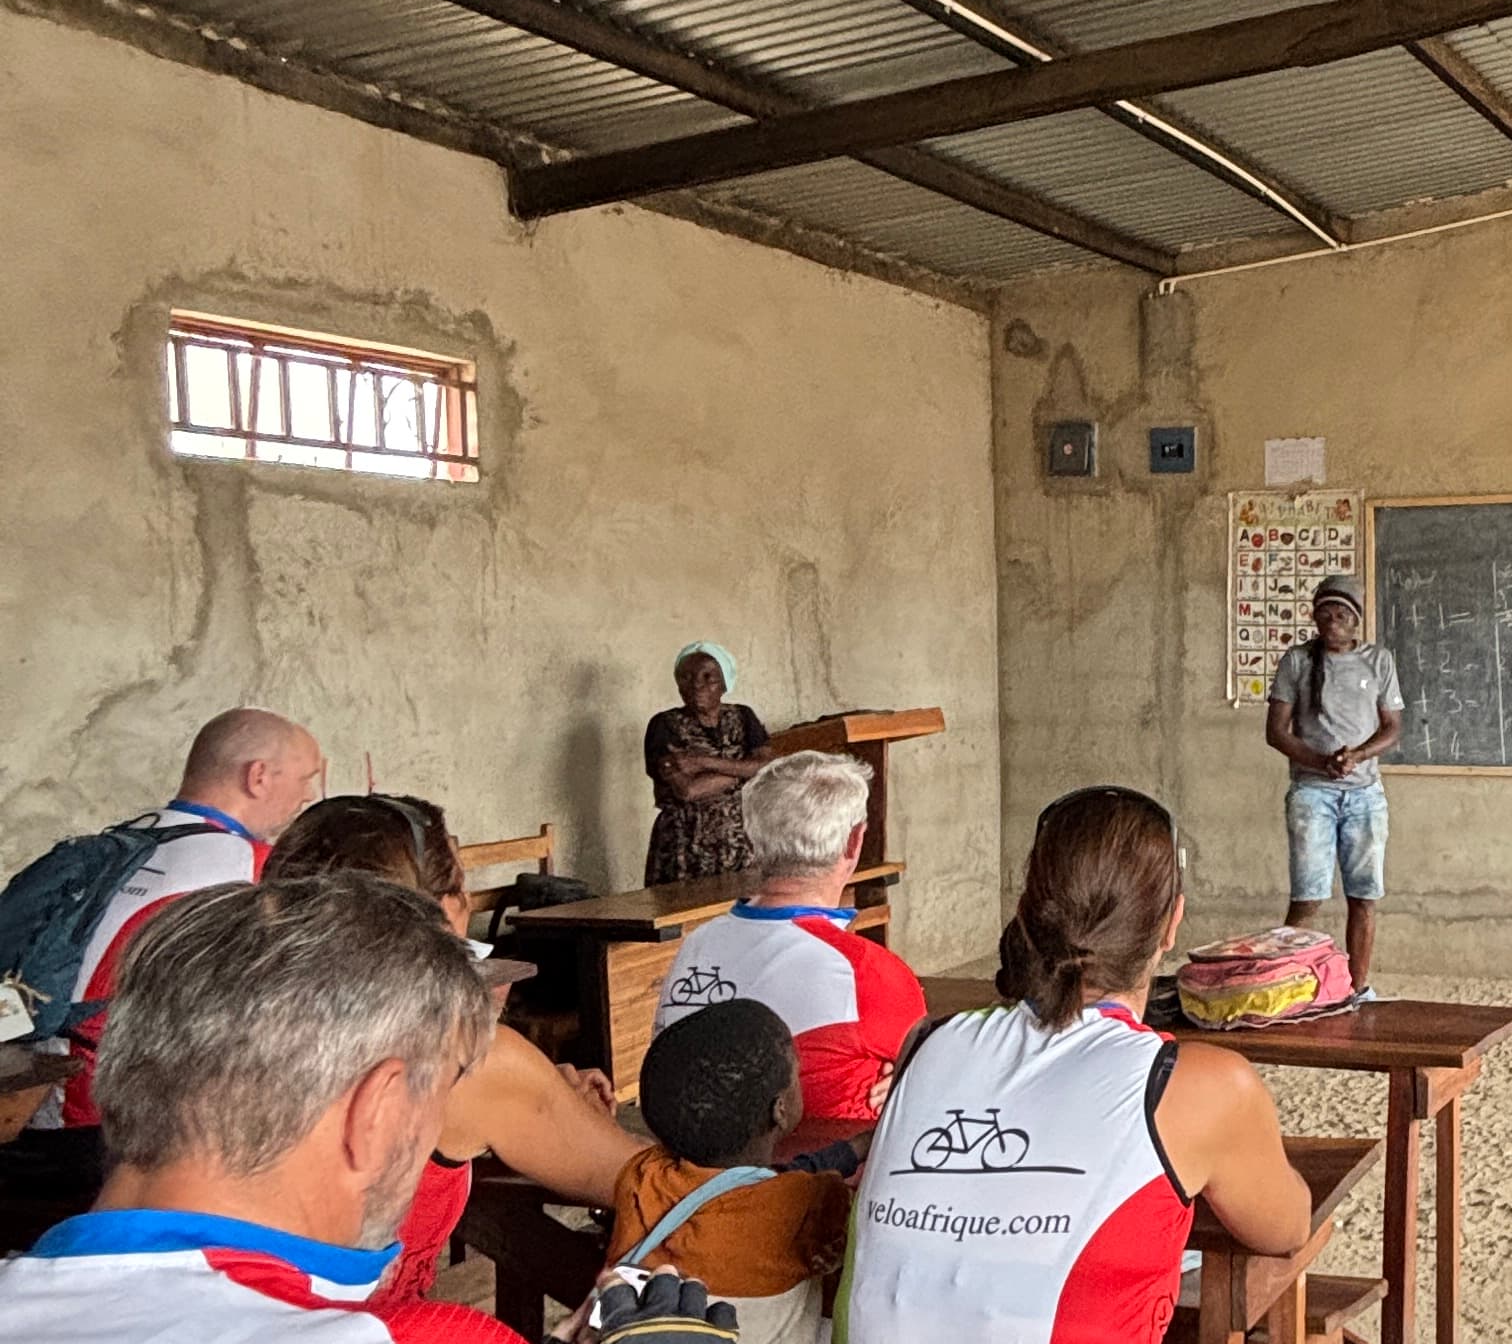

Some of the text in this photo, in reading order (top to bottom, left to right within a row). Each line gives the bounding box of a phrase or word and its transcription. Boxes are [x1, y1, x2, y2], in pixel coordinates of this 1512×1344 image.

[1240, 528, 1339, 542] A B C D
[1240, 553, 1338, 567] E F G H
[1269, 579, 1278, 591] J
[1298, 579, 1308, 591] K
[1239, 603, 1251, 616] M
[1269, 604, 1279, 616] N
[1239, 629, 1308, 641] Q R S
[1239, 653, 1249, 666] U
[868, 1198, 1071, 1242] veloafrique.com
